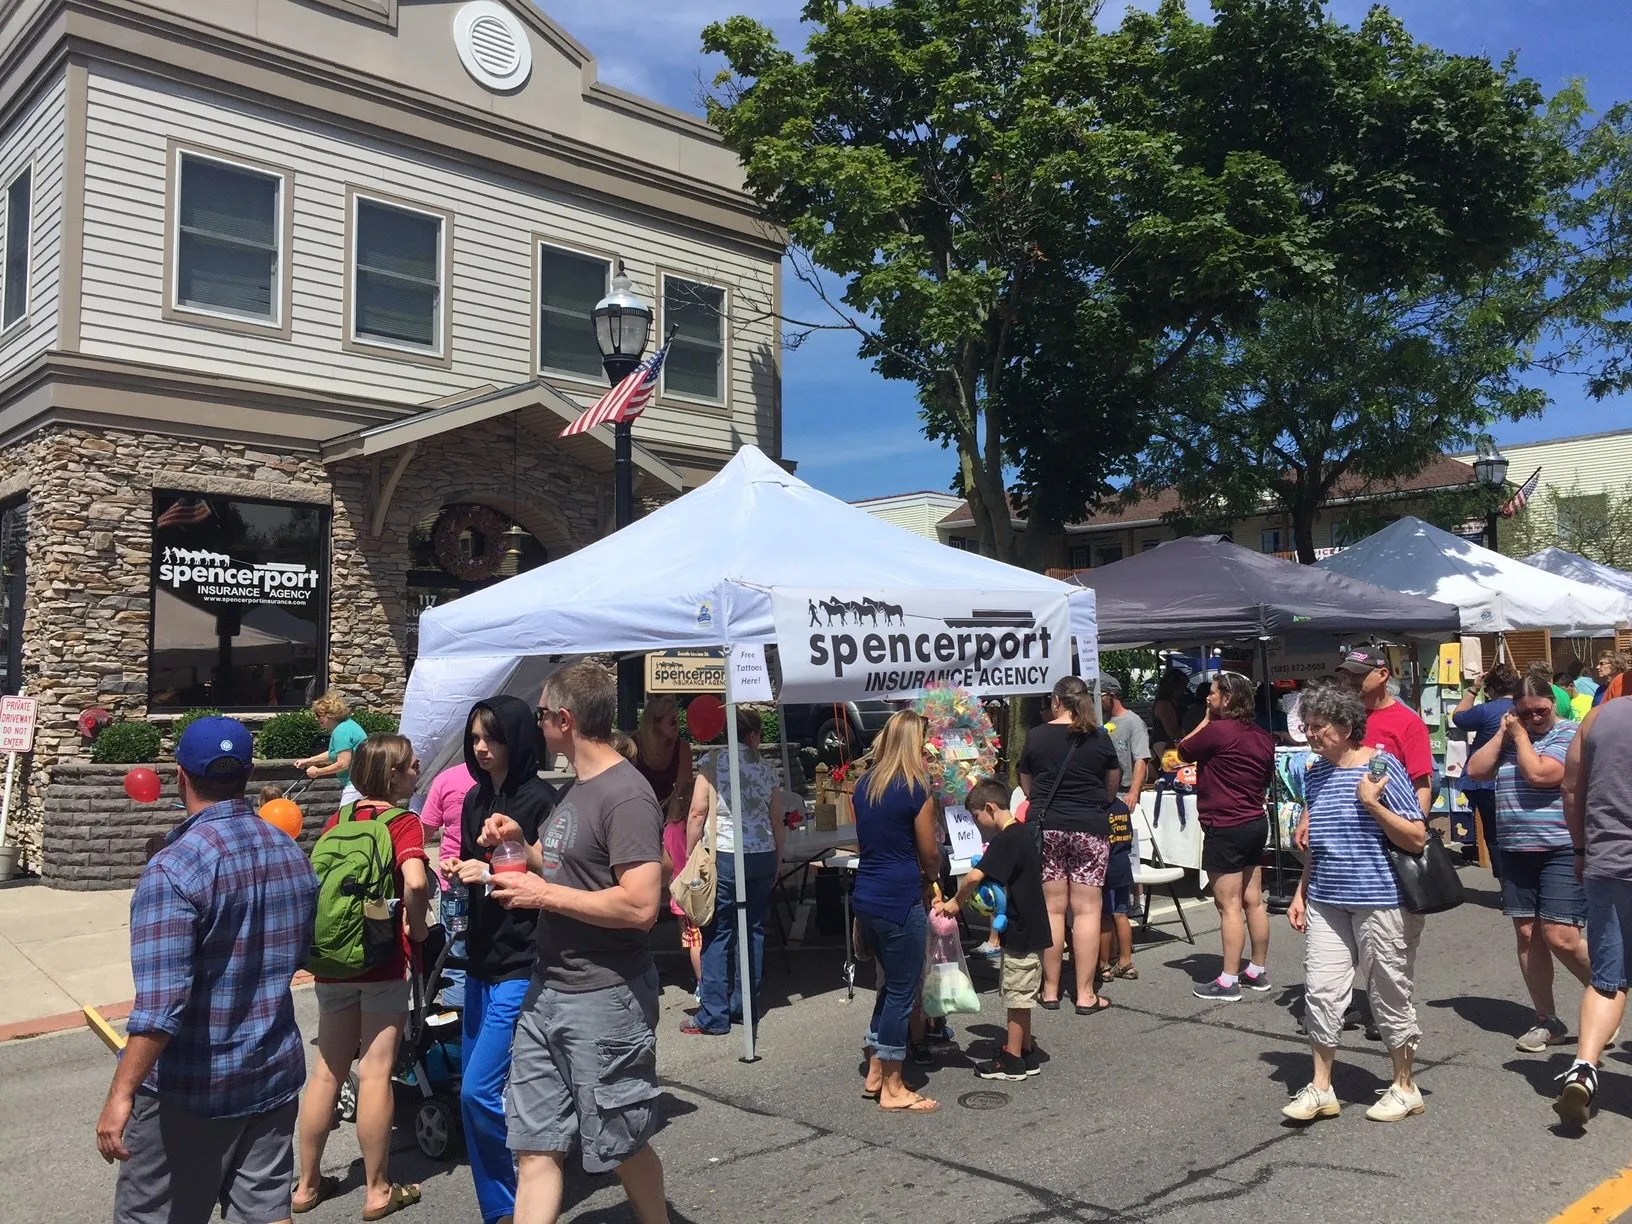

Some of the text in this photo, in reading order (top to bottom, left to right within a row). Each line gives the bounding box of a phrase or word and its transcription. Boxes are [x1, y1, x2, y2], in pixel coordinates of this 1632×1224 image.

[159, 564, 319, 592] spencerport
[197, 586, 311, 599] INSURANCE AGENCY
[204, 596, 307, 606] www.spencerportinsurance.com
[419, 595, 437, 606] 117
[741, 651, 756, 659] Free
[809, 626, 1052, 678] spencerport
[736, 664, 763, 672] Tattoos
[655, 669, 726, 683] spencerpor
[741, 677, 761, 685] Here!
[864, 665, 1050, 692] INSURANCE AGENCY
[7, 702, 31, 711] PRIVATE
[2, 714, 32, 723] DRIVEWAY
[3, 727, 11, 735] DO
[4, 738, 23, 746] ENTER
[958, 829, 973, 840] Me!
